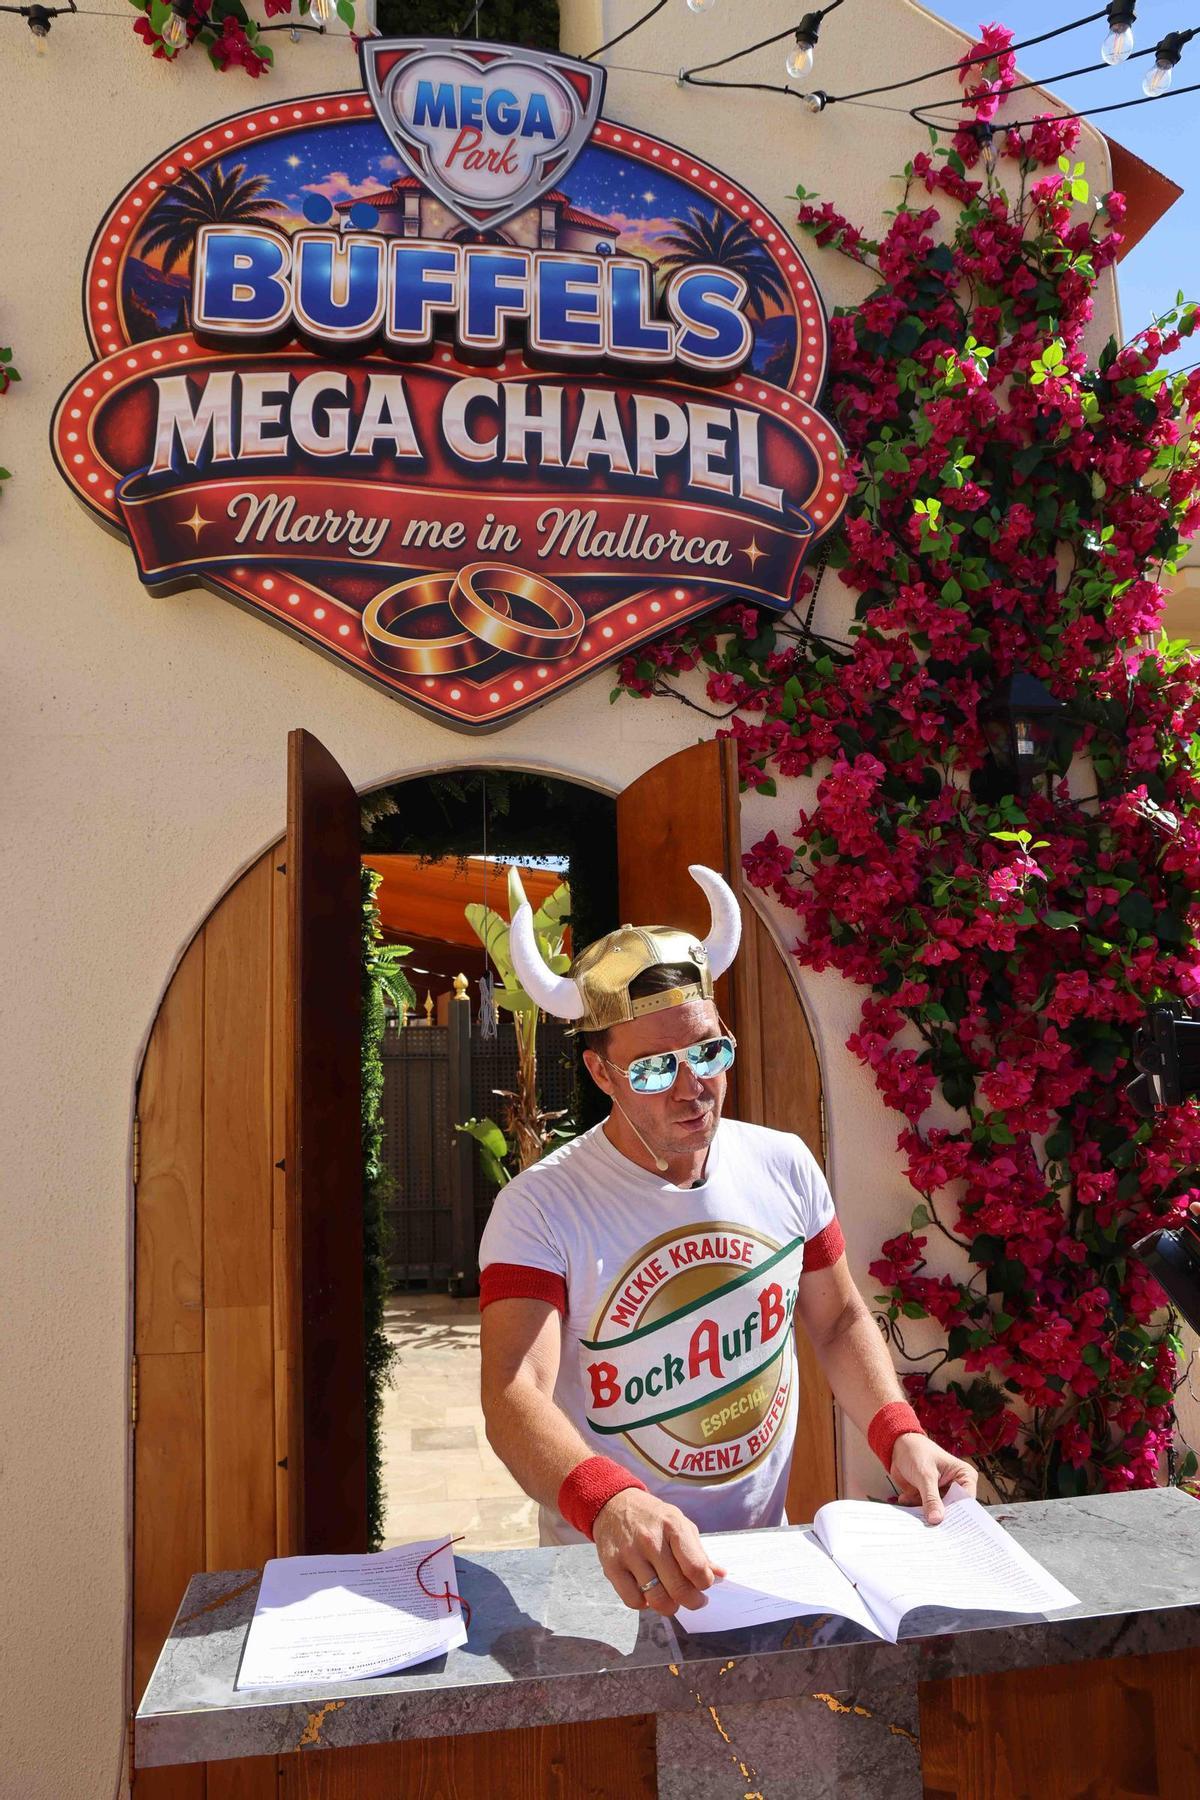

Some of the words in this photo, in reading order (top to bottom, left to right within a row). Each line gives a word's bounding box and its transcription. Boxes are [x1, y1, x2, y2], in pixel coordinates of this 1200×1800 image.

[411, 80, 557, 142] MEGA
[444, 129, 519, 178] Park
[195, 194, 754, 371] BÜFFELS
[150, 370, 420, 476] MEGA
[441, 378, 785, 512] CHAPEL
[226, 492, 391, 556] Marry
[402, 517, 466, 552] me
[477, 512, 521, 551] in
[536, 506, 733, 567] Mallorca
[610, 1257, 669, 1328] MICKIE
[668, 1237, 754, 1269] KRAUSE
[668, 1444, 744, 1473] LORENZ
[746, 1383, 789, 1457] BÜFFEL
[700, 1386, 770, 1438] ESPECIAL
